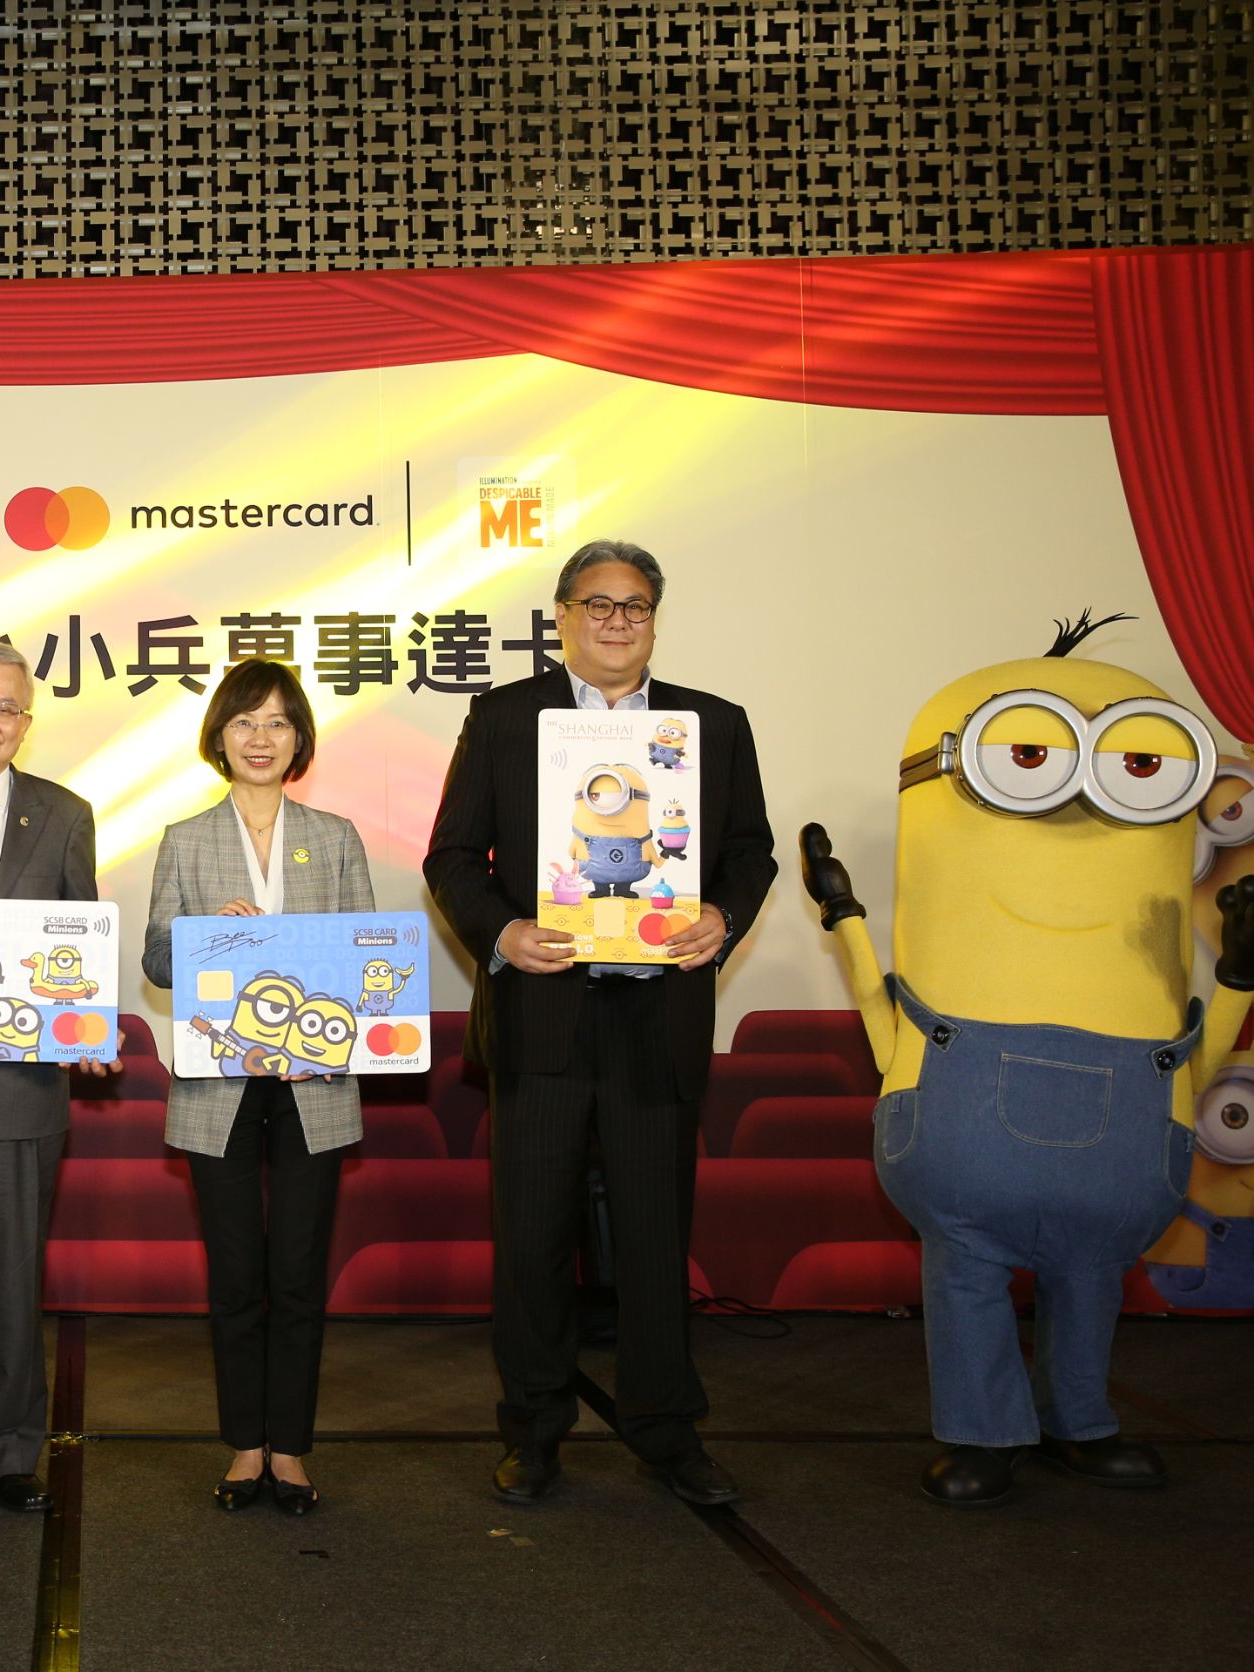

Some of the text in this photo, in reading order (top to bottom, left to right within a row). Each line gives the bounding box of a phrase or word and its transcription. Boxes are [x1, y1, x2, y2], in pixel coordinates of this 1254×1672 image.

[479, 487, 541, 499] DESPICABLE
[131, 494, 374, 529] mastercard
[480, 500, 543, 548] ME
[558, 723, 633, 735] SHANGHAI
[43, 916, 88, 925] SCSB CARD
[47, 925, 84, 934] Minions
[353, 927, 397, 936] SCSB CARD
[357, 937, 393, 945] Minions
[54, 1047, 105, 1056] mastercard
[369, 1056, 419, 1066] mastercard
